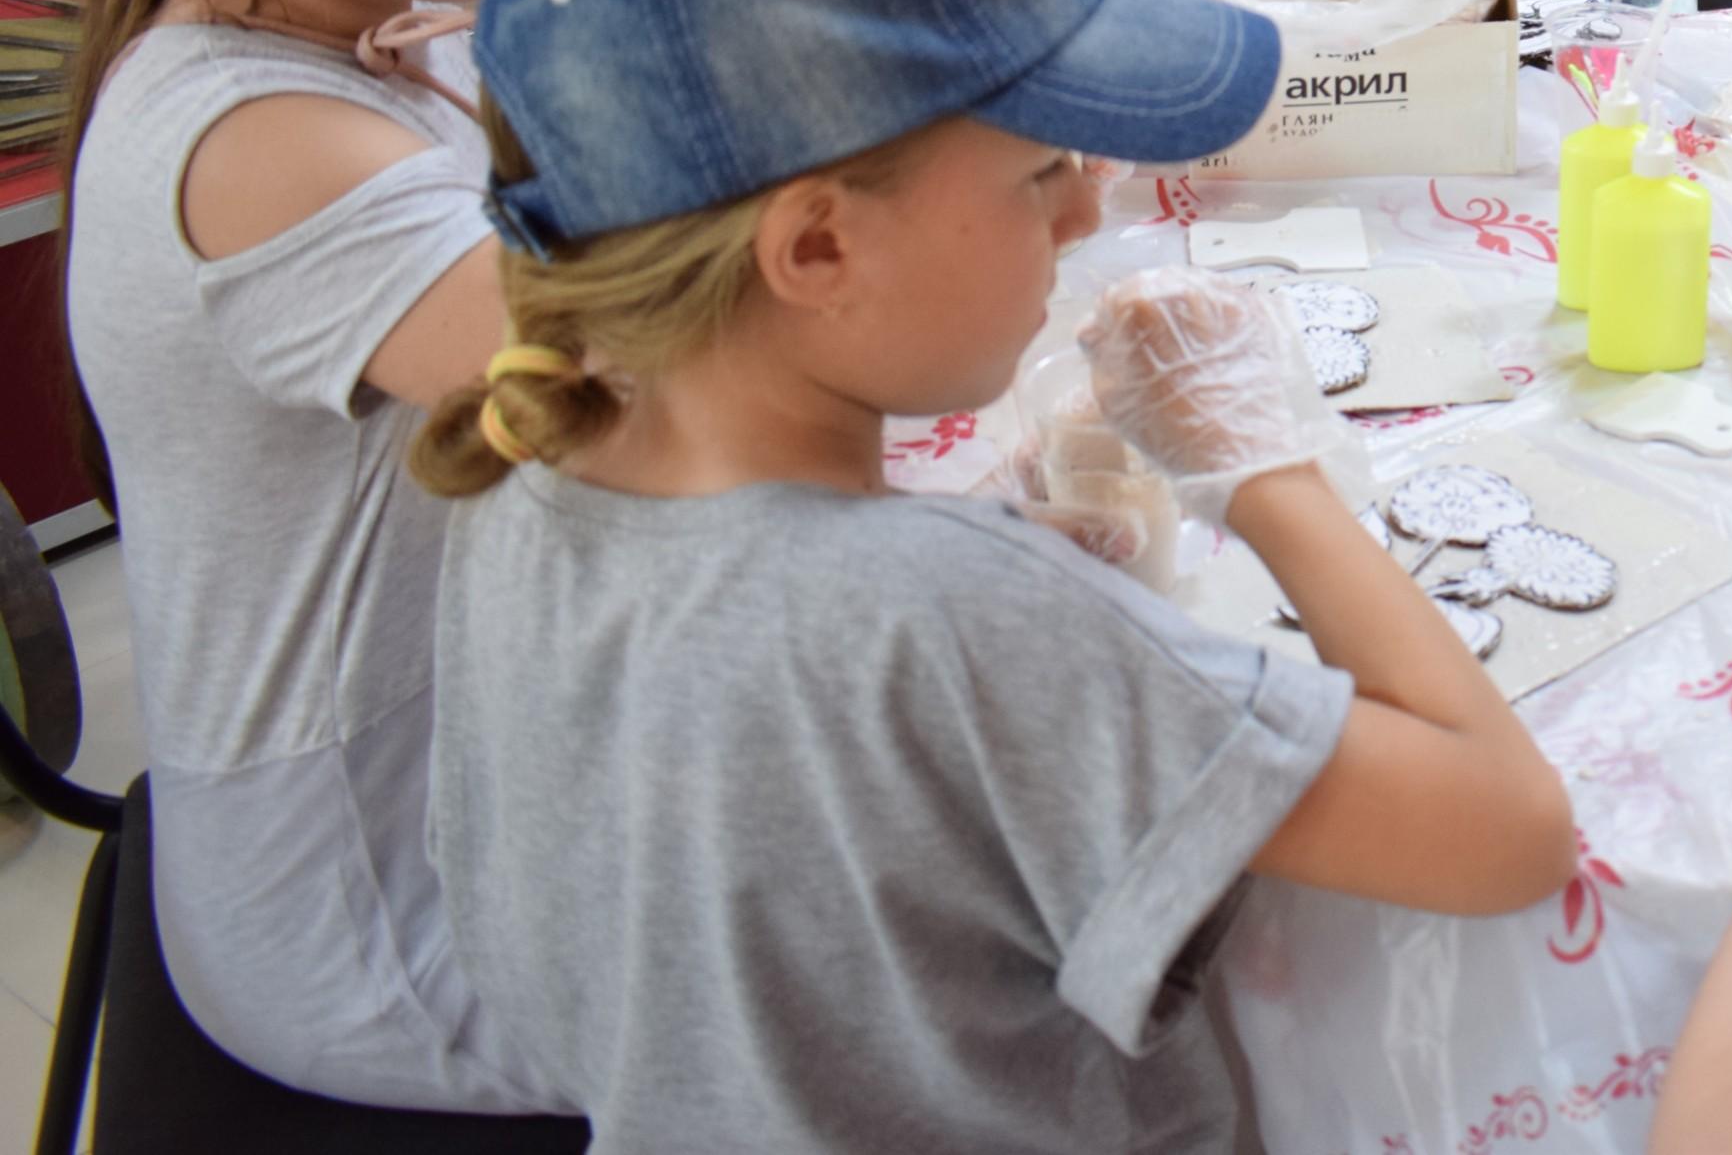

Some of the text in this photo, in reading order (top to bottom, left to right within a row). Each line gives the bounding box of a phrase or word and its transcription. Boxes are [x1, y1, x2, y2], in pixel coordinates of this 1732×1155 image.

[1285, 71, 1408, 105] акрил
[1282, 113, 1335, 127] ГЛЯН
[1282, 127, 1322, 138] ХУДО
